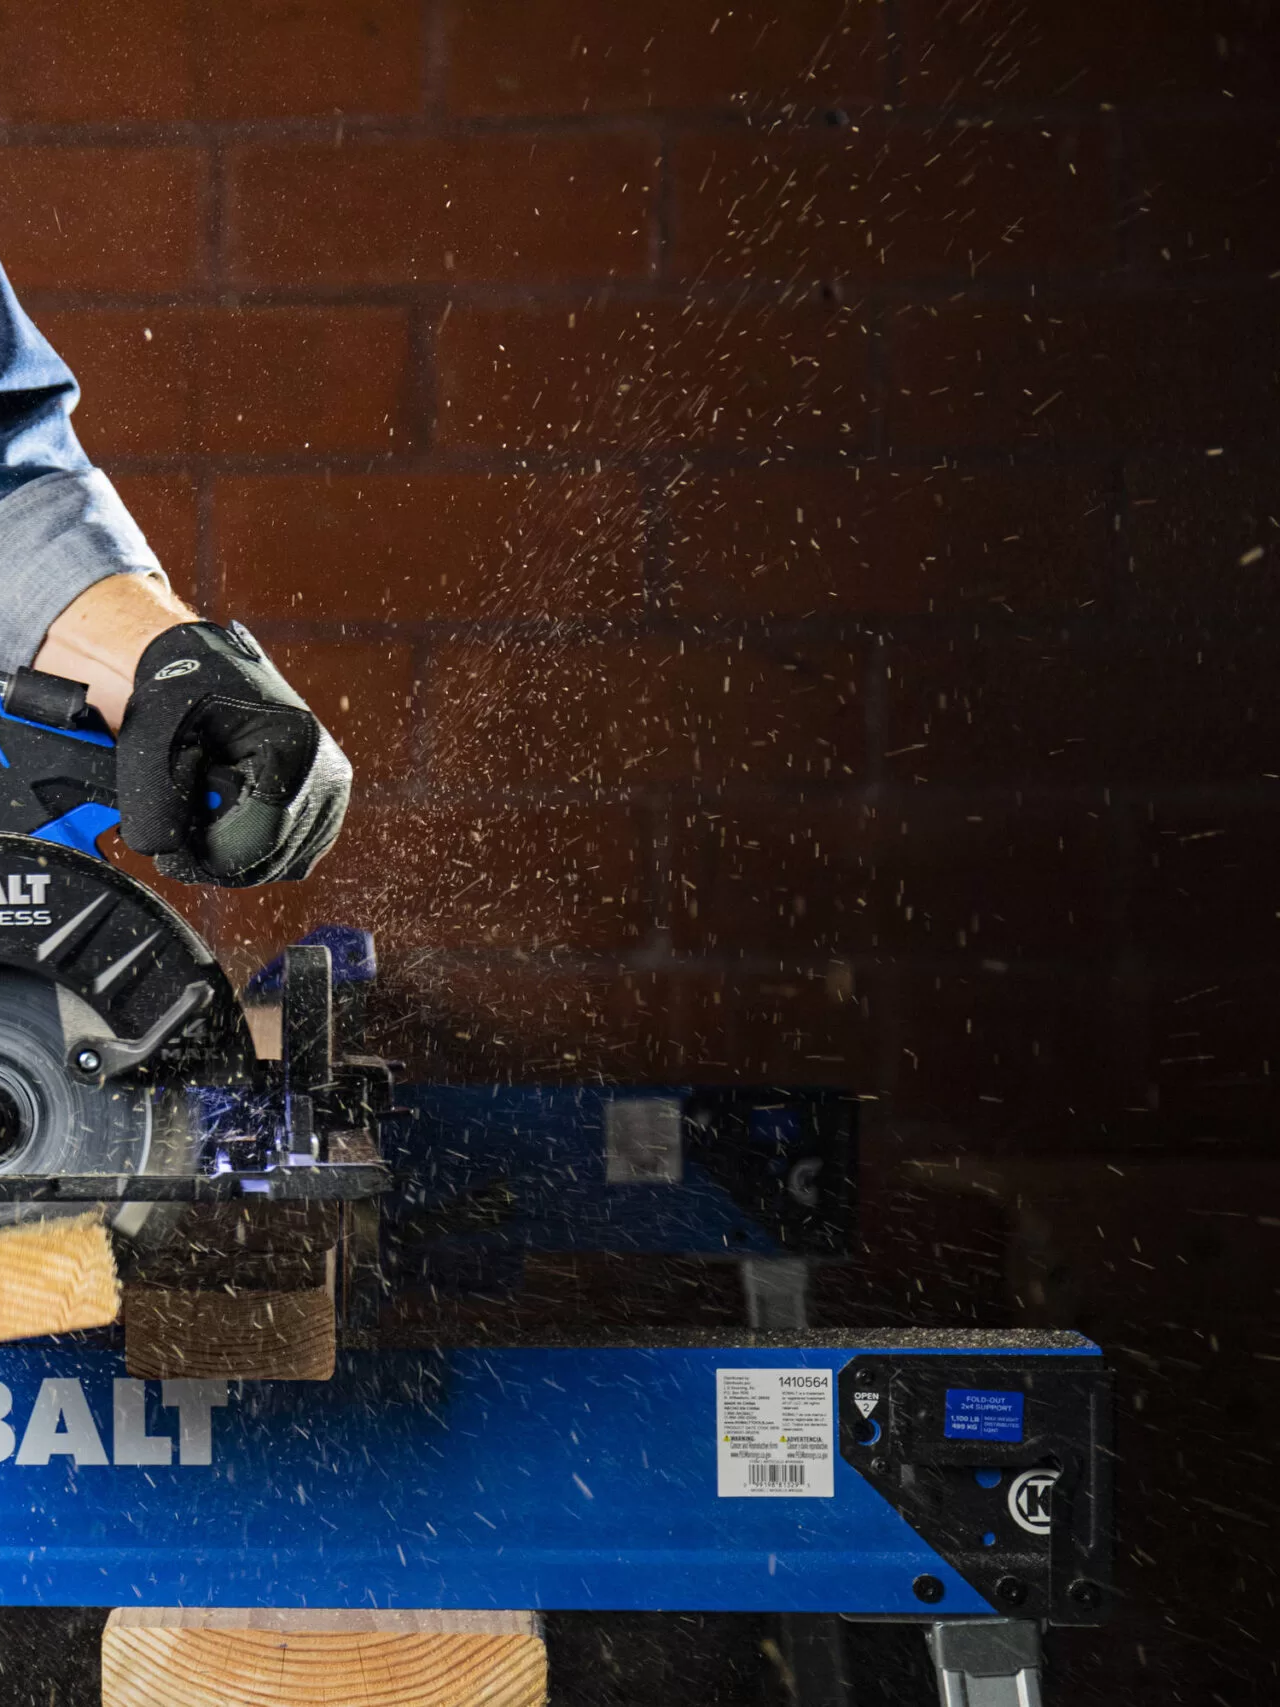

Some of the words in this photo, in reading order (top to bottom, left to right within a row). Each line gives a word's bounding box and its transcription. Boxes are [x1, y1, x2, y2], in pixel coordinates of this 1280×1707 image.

[779, 1376, 829, 1388] 1410564
[854, 1392, 879, 1400] OPEN
[966, 1396, 1006, 1404] FOLD-OUT
[863, 1403, 870, 1412] 2
[975, 1404, 1012, 1412] SUPPORT
